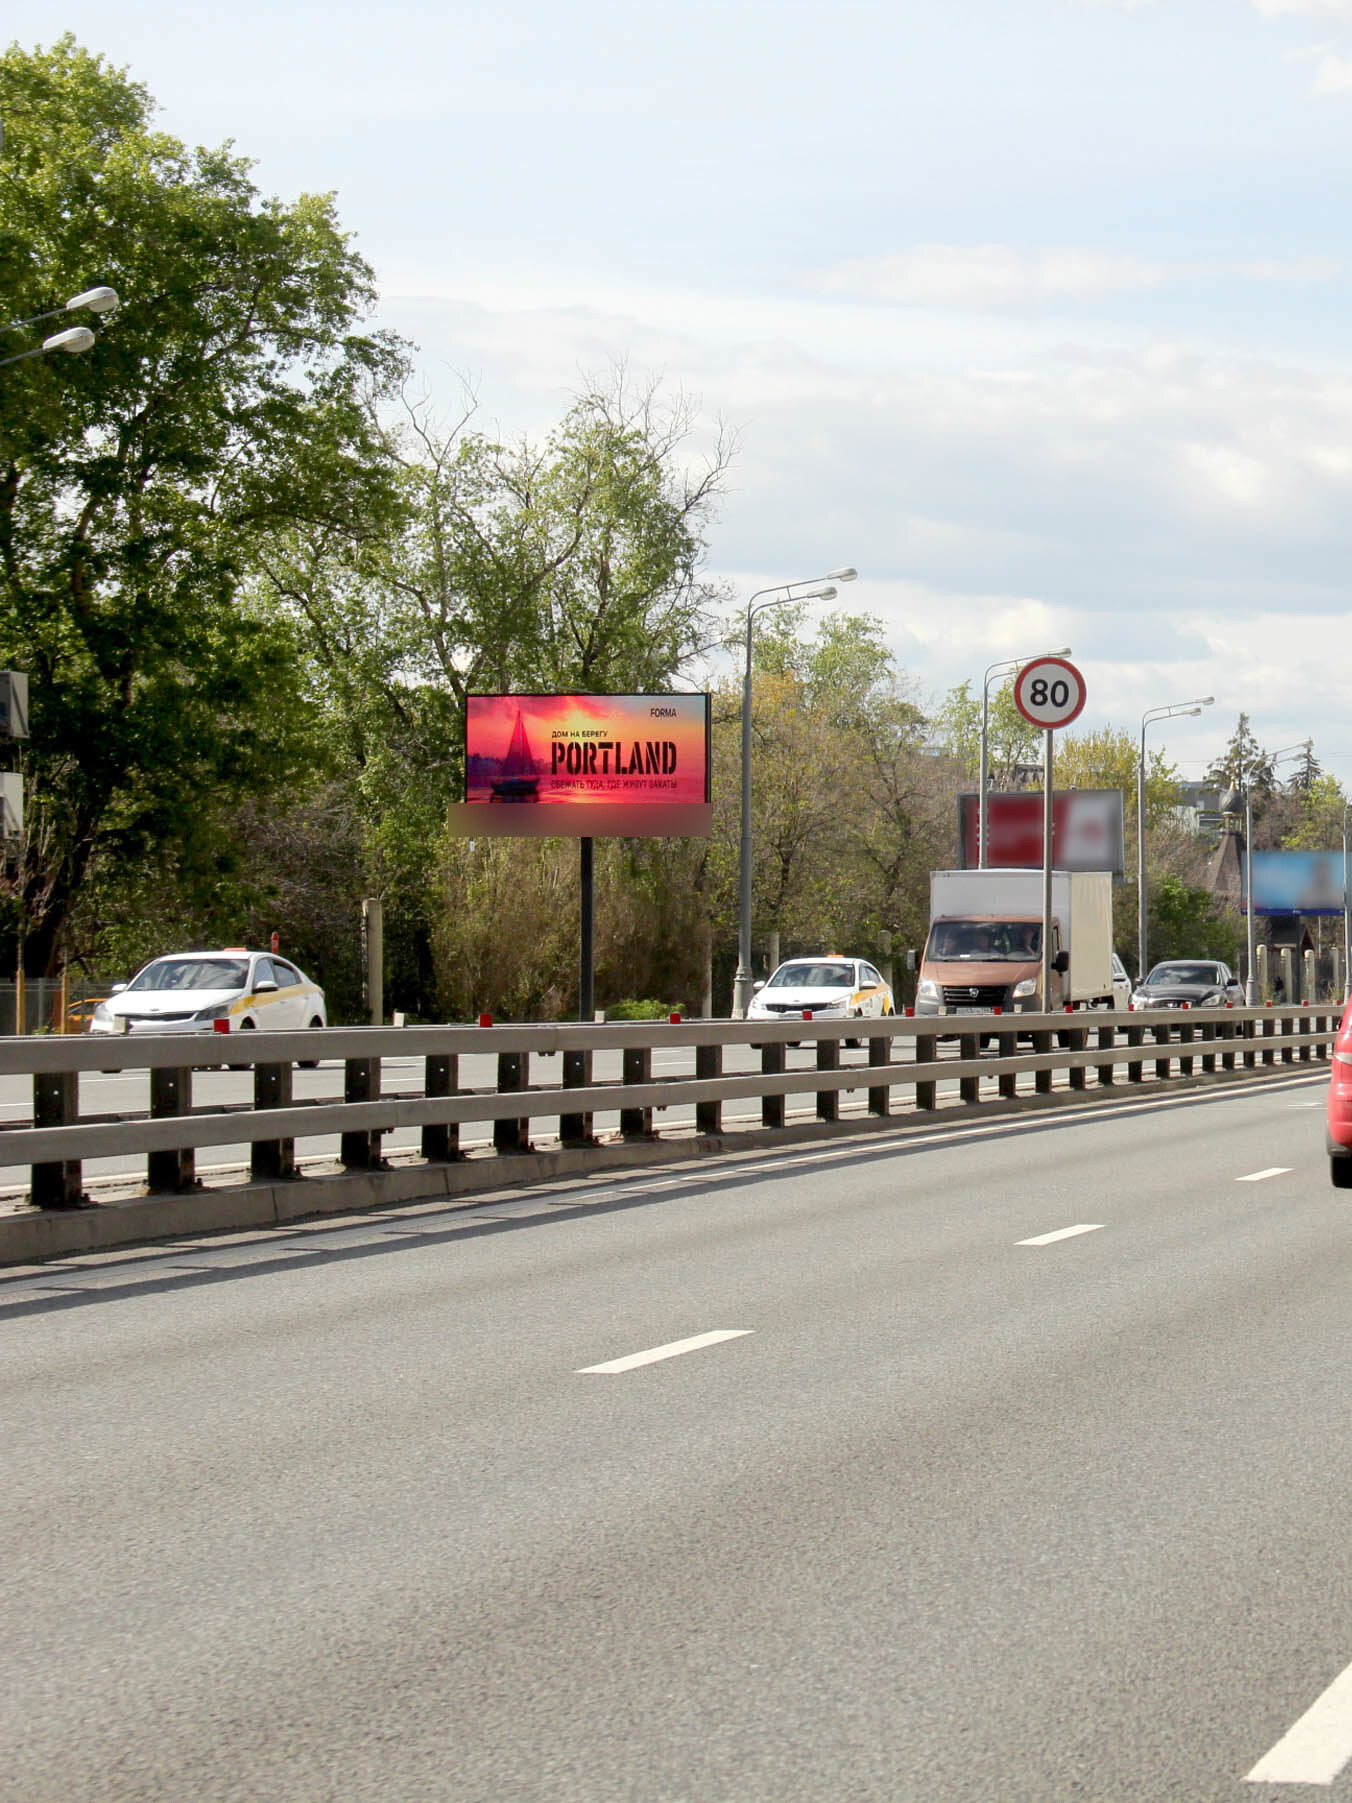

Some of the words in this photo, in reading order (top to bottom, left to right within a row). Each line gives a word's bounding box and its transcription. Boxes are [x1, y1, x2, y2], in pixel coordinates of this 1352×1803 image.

[1030, 679, 1070, 708] 80
[650, 708, 677, 718] FORMA
[551, 731, 568, 739] ДОМ
[570, 730, 580, 738] НА
[582, 730, 608, 738] БЕРЕГУ
[551, 741, 677, 775] PORTLAND
